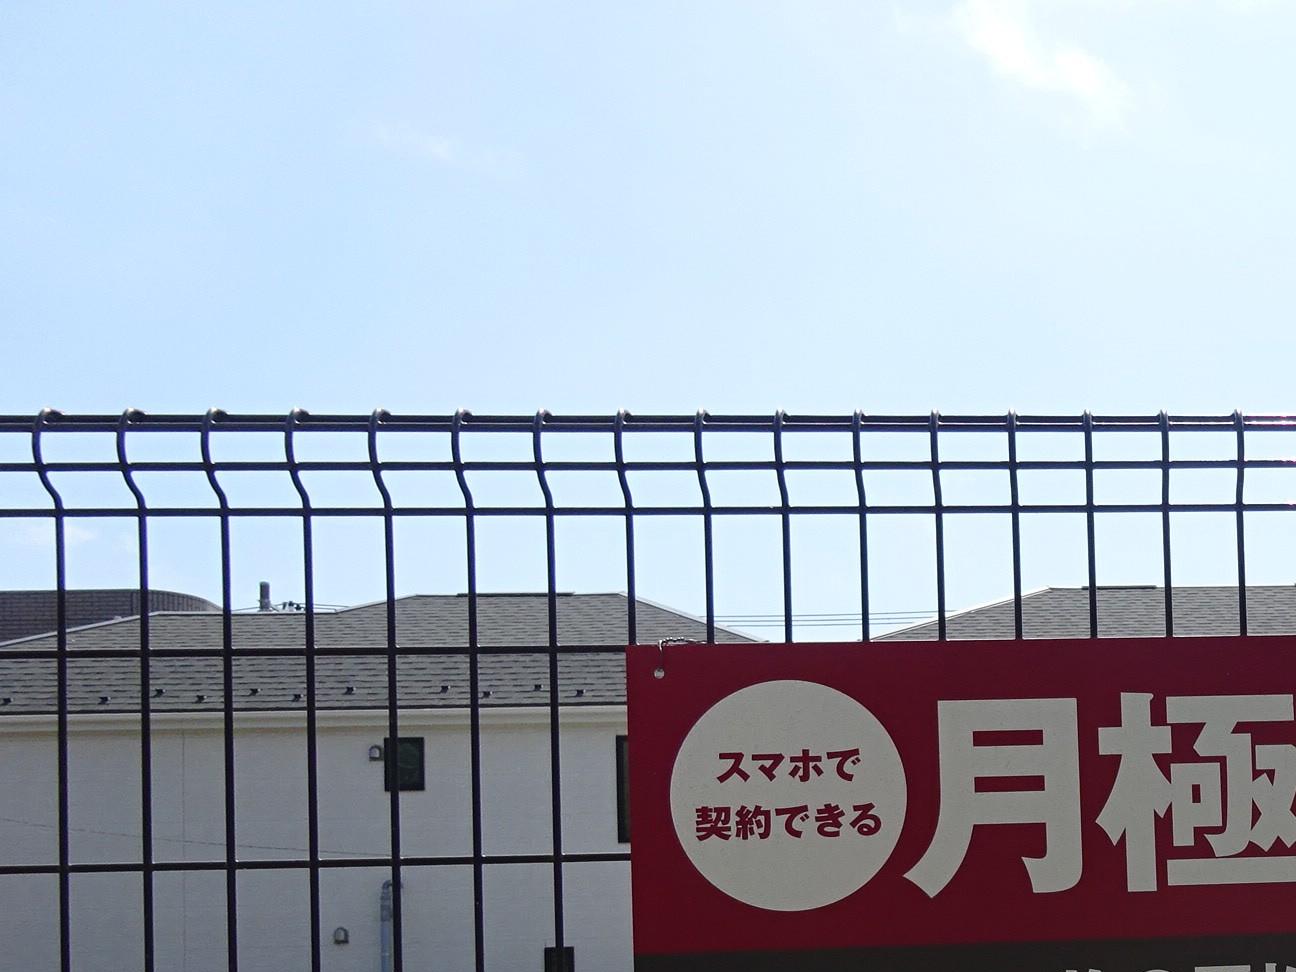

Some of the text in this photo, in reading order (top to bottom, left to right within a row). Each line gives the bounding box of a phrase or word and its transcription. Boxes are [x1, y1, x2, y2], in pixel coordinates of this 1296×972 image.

[717, 748, 861, 783] スマホで
[696, 803, 881, 841] 契約できる
